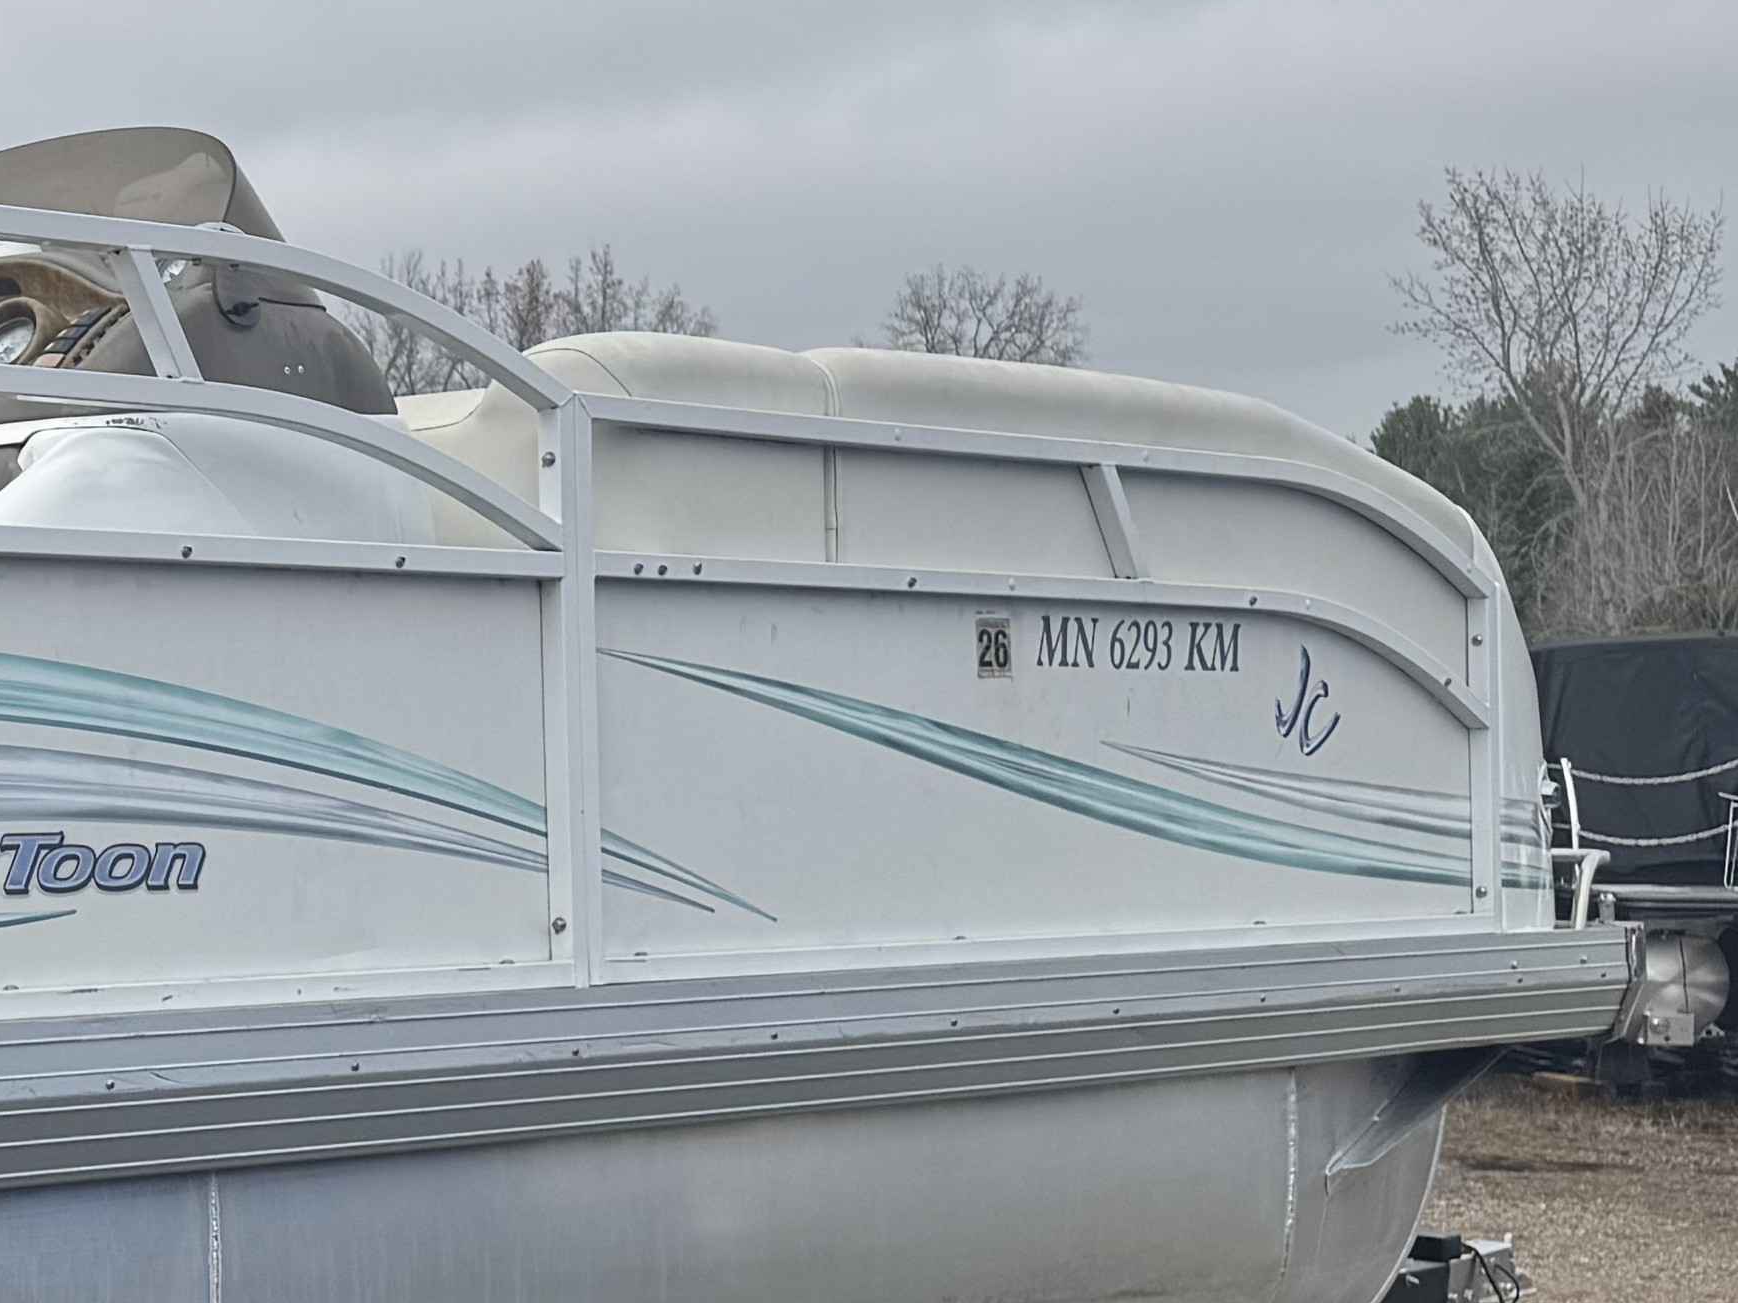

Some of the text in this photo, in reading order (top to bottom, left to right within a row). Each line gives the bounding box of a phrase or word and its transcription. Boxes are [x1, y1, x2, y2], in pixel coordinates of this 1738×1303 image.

[977, 628, 1009, 669] 26
[1036, 615, 1243, 673] MN 6293 KM
